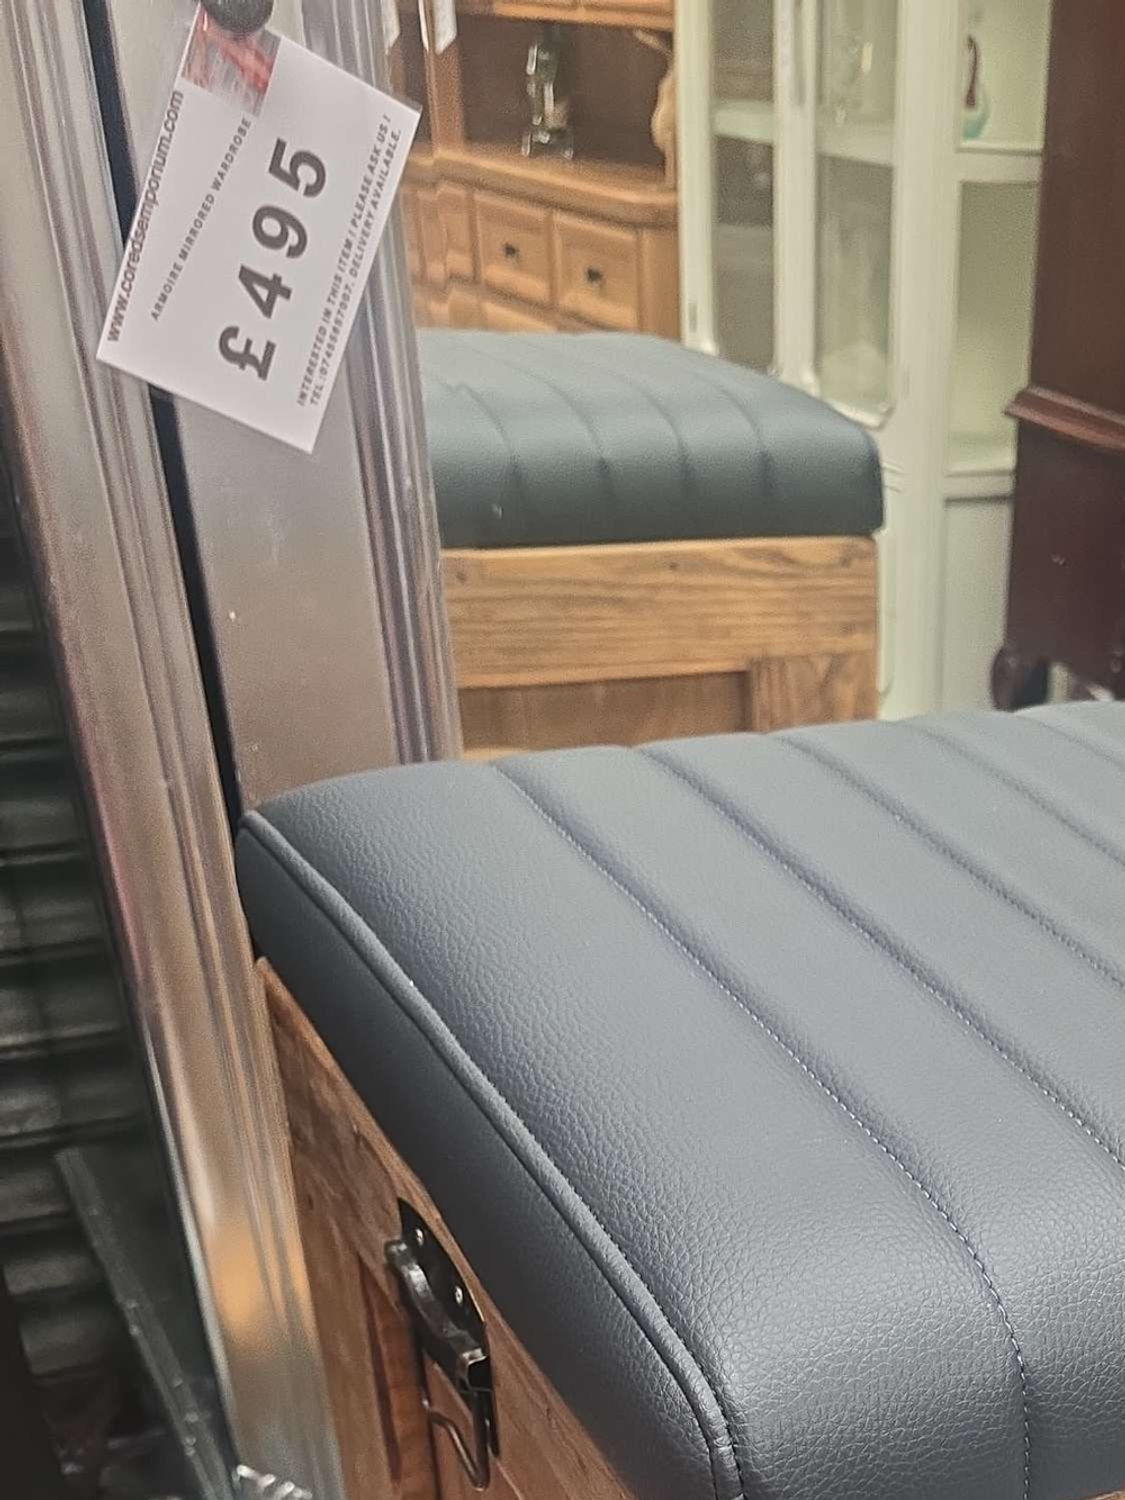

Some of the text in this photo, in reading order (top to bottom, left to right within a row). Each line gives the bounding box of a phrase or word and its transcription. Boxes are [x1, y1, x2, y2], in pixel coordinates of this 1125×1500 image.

[378, 124, 390, 145] US
[366, 146, 382, 177] ASK
[107, 89, 184, 342] www.coredsemporium.com
[151, 117, 252, 321] ARMOIRE MIRRORED WARDROBE
[353, 173, 374, 230] PLEASE
[340, 238, 354, 273] ITEM
[349, 210, 376, 279] DELIVERY
[327, 272, 343, 307] THIS
[321, 307, 334, 324] IN
[297, 322, 328, 406] INTERESTED
